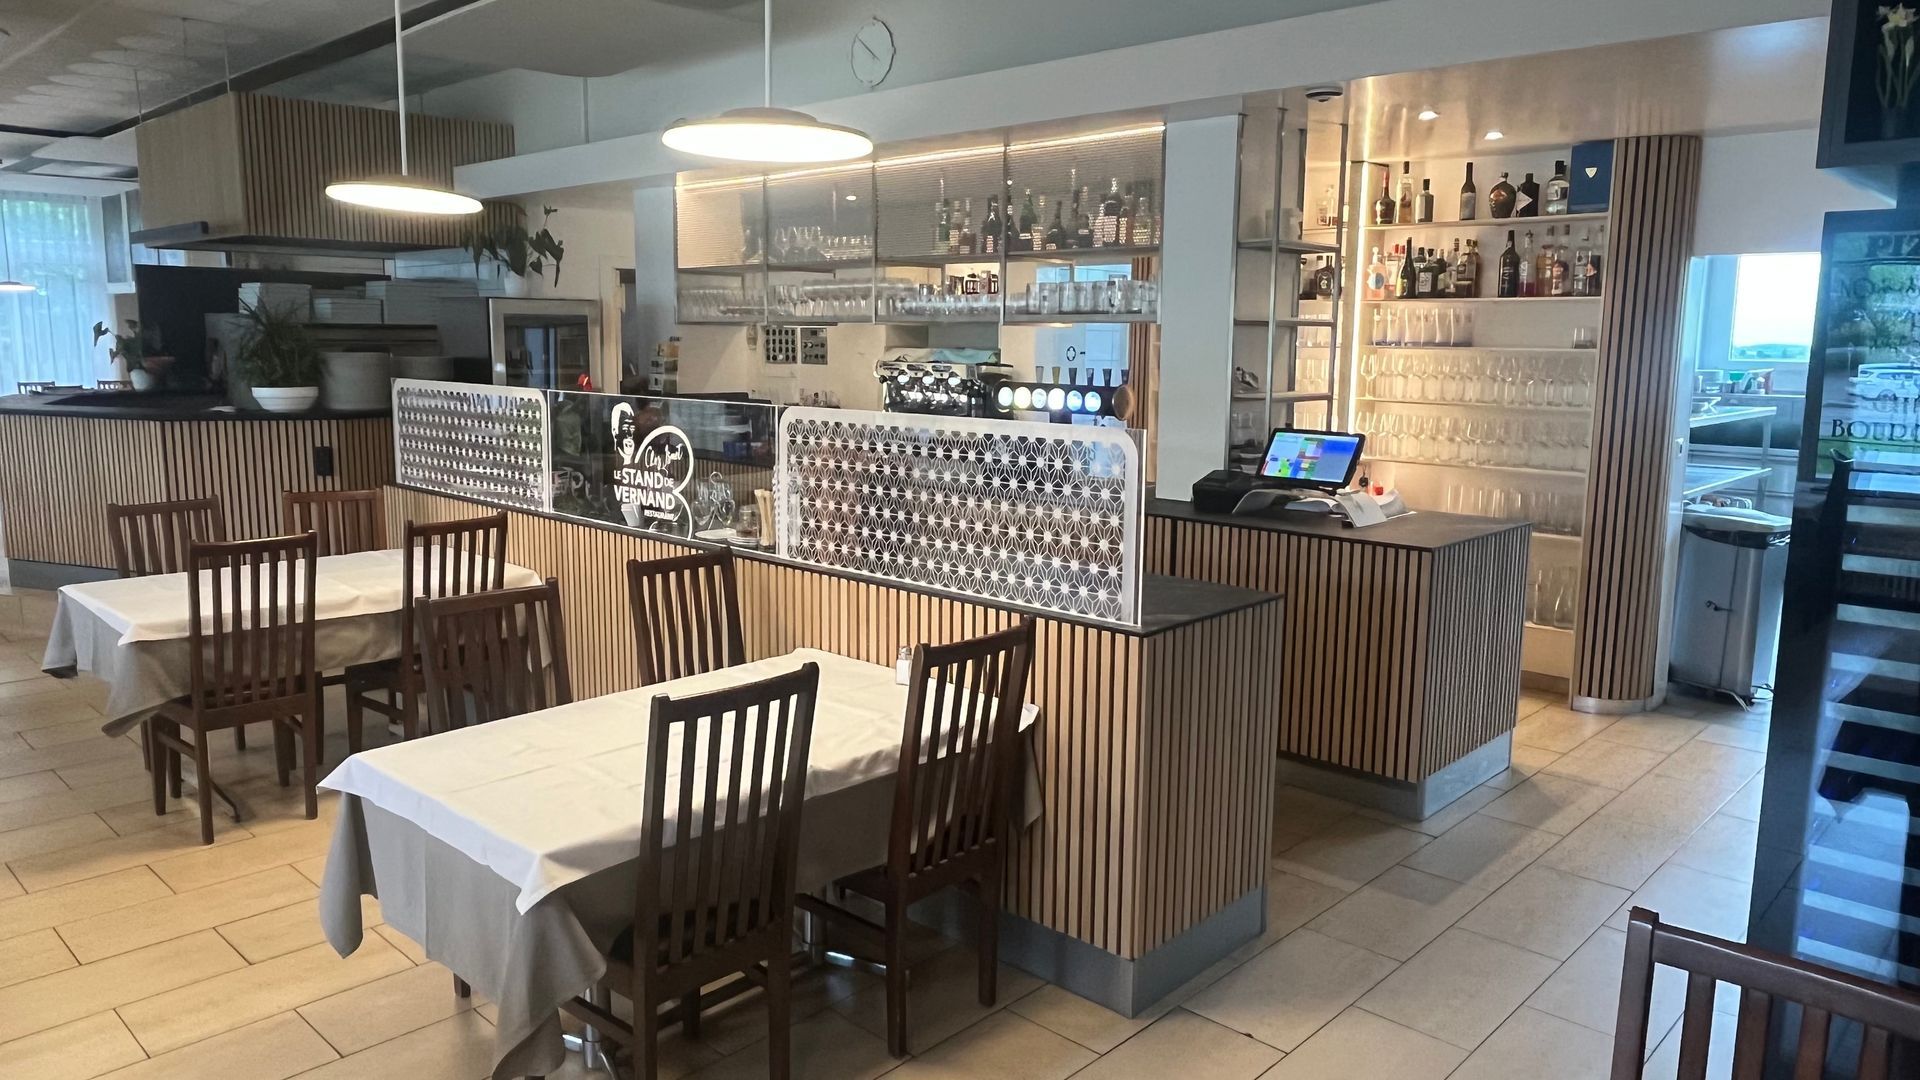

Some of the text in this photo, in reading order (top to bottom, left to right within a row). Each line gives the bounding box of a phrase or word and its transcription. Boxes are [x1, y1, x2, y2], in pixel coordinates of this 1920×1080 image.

[613, 468, 674, 489] LE STAND DE
[613, 484, 676, 510] VERNAND
